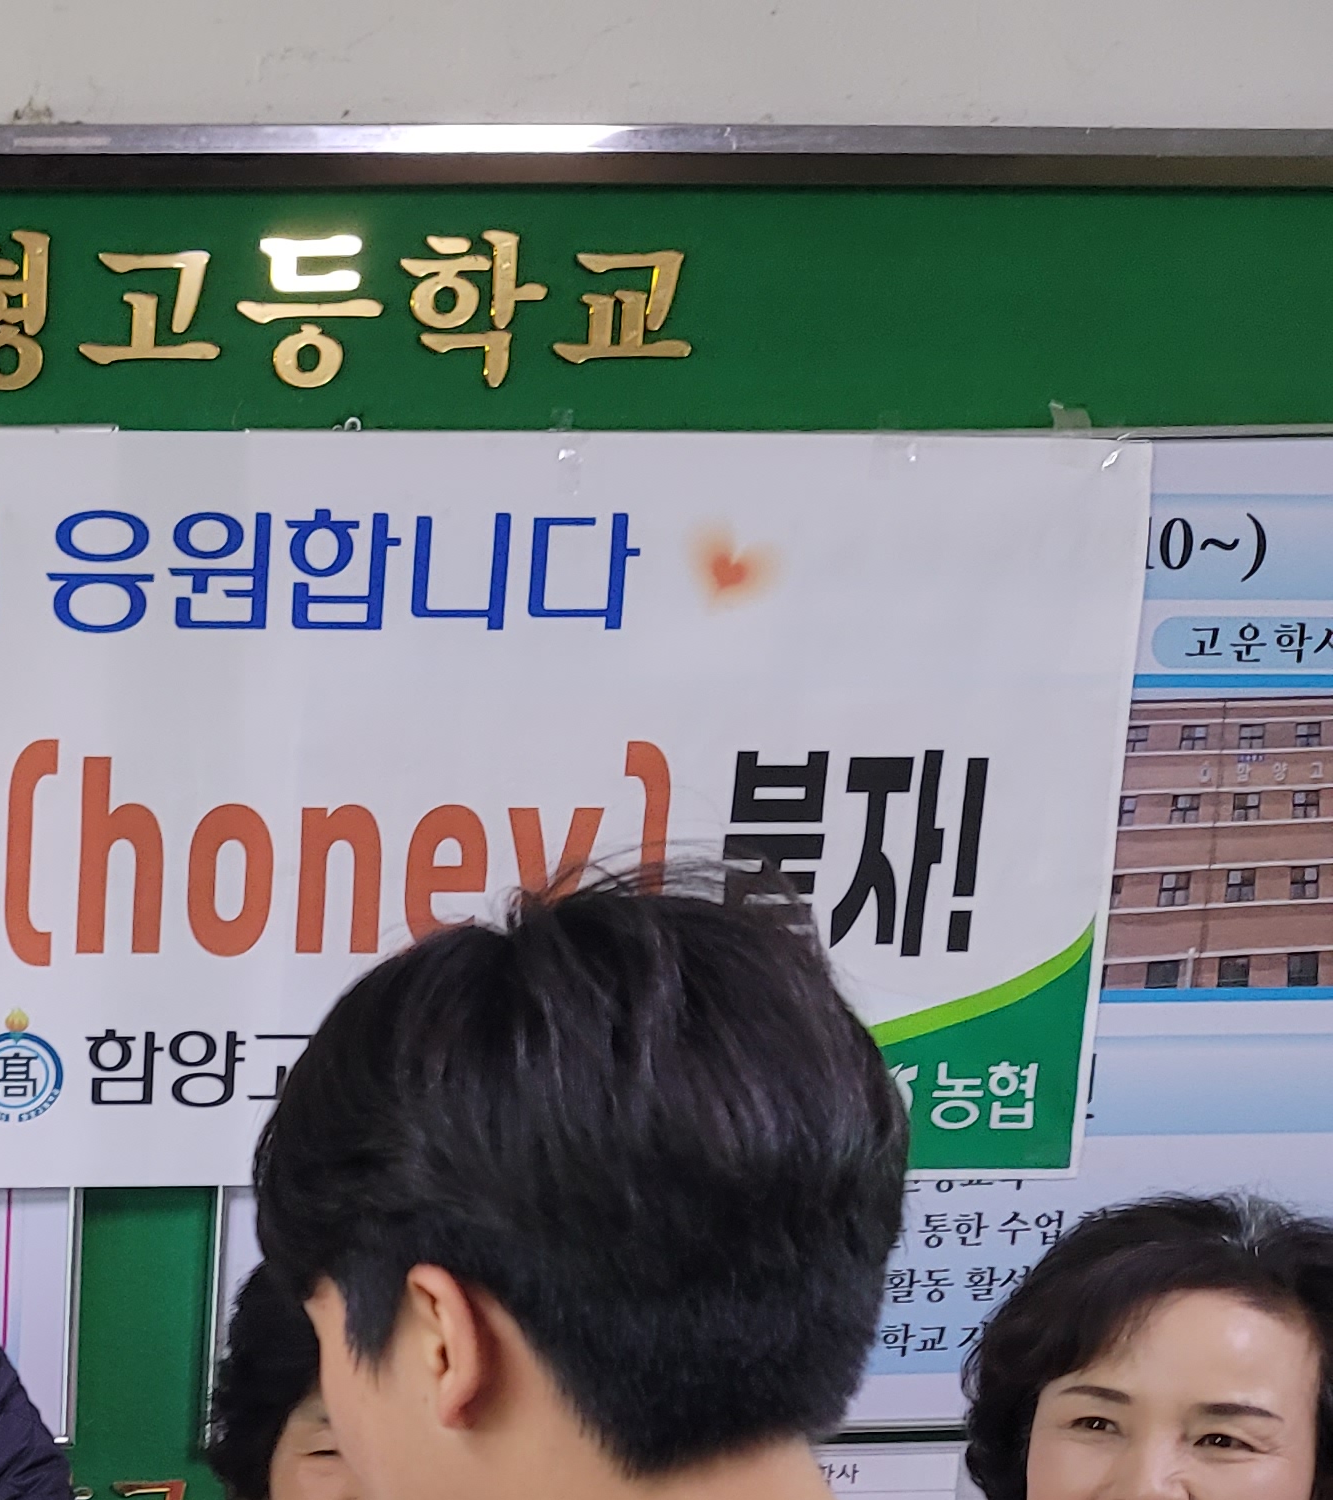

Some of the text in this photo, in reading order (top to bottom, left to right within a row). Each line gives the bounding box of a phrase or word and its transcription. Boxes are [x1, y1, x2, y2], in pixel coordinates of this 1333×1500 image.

[45, 507, 642, 635] 응원합니다
[721, 748, 991, 957] 붙자!
[930, 1060, 1039, 1130] 농협
[917, 1211, 990, 1248] 통한
[997, 1209, 1066, 1247] 수업
[884, 1267, 955, 1304] 활동
[880, 1323, 949, 1358] 학교
